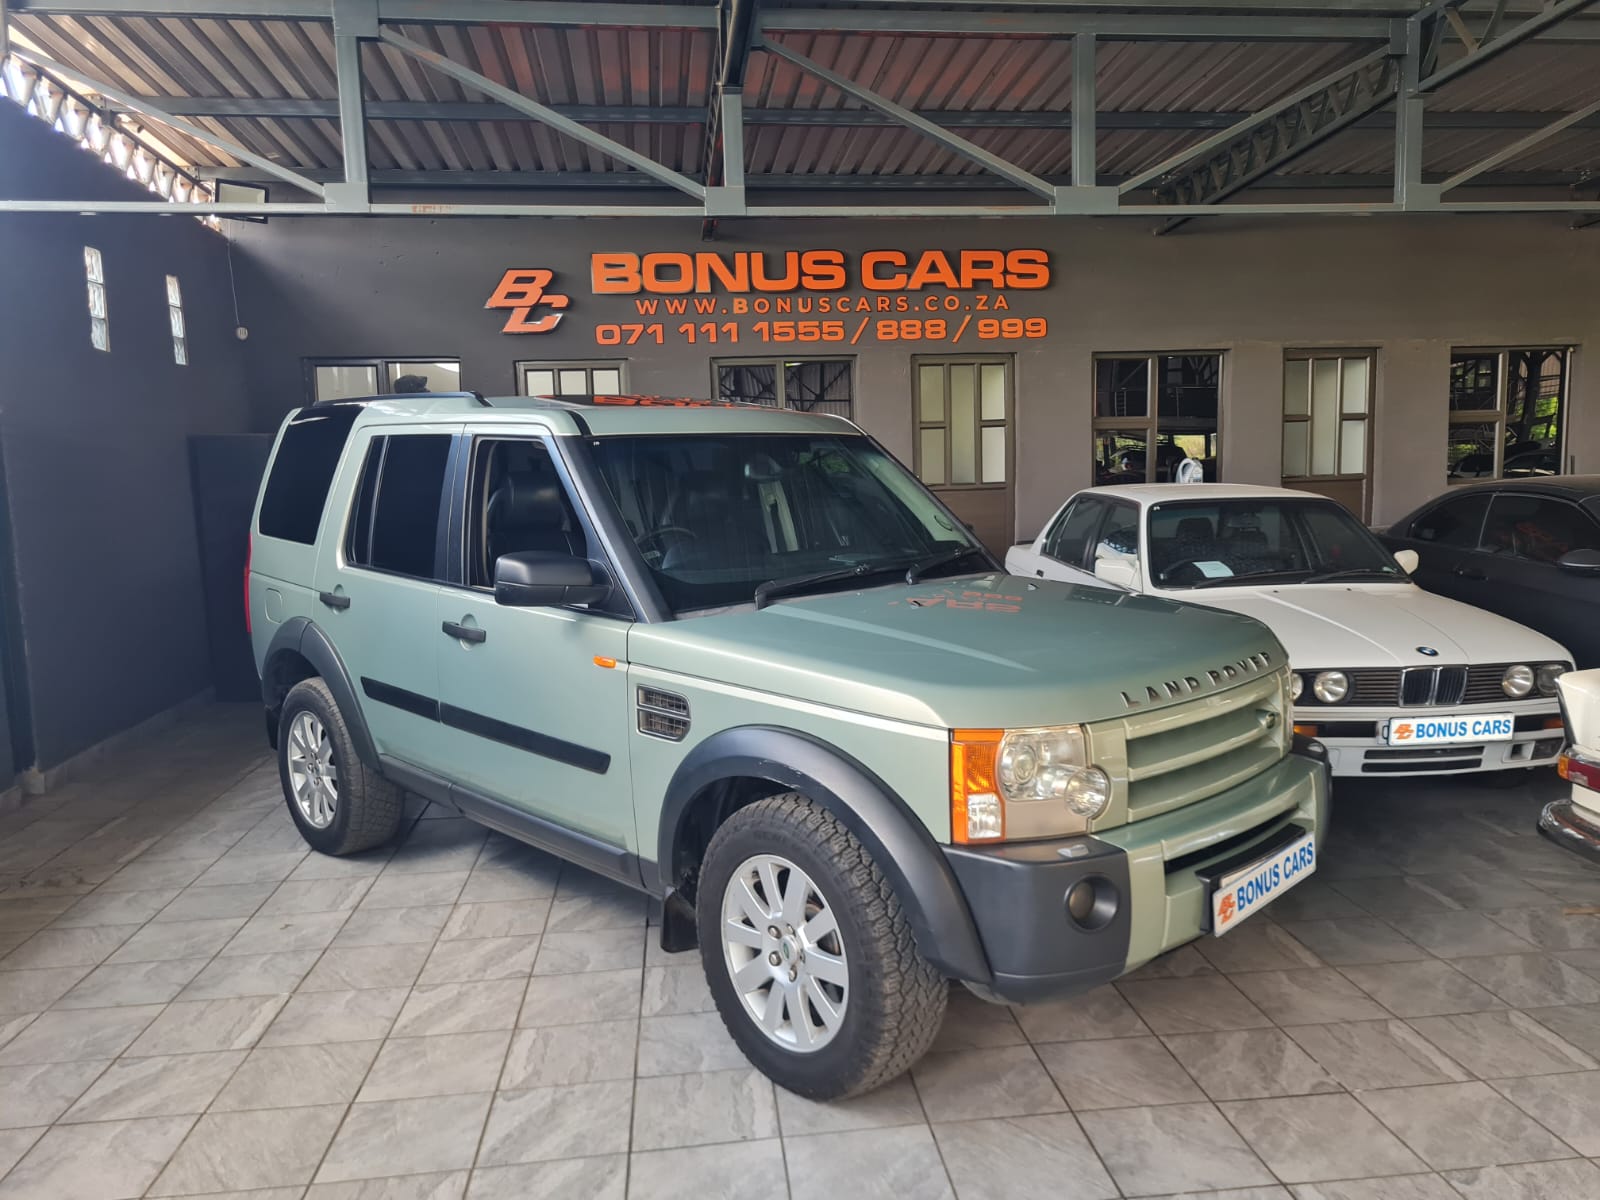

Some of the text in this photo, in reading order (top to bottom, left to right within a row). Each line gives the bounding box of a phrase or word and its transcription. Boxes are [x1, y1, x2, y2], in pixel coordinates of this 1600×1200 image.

[591, 249, 1050, 294] BONUS CARS
[484, 268, 569, 334] BC
[595, 323, 665, 345] 071
[678, 322, 740, 343] 111
[1120, 652, 1271, 708] LAND ROVER
[1415, 721, 1468, 739] BONUS
[1472, 719, 1512, 736] CARS
[1236, 863, 1280, 912] BONUS
[1283, 841, 1313, 880] CARS
